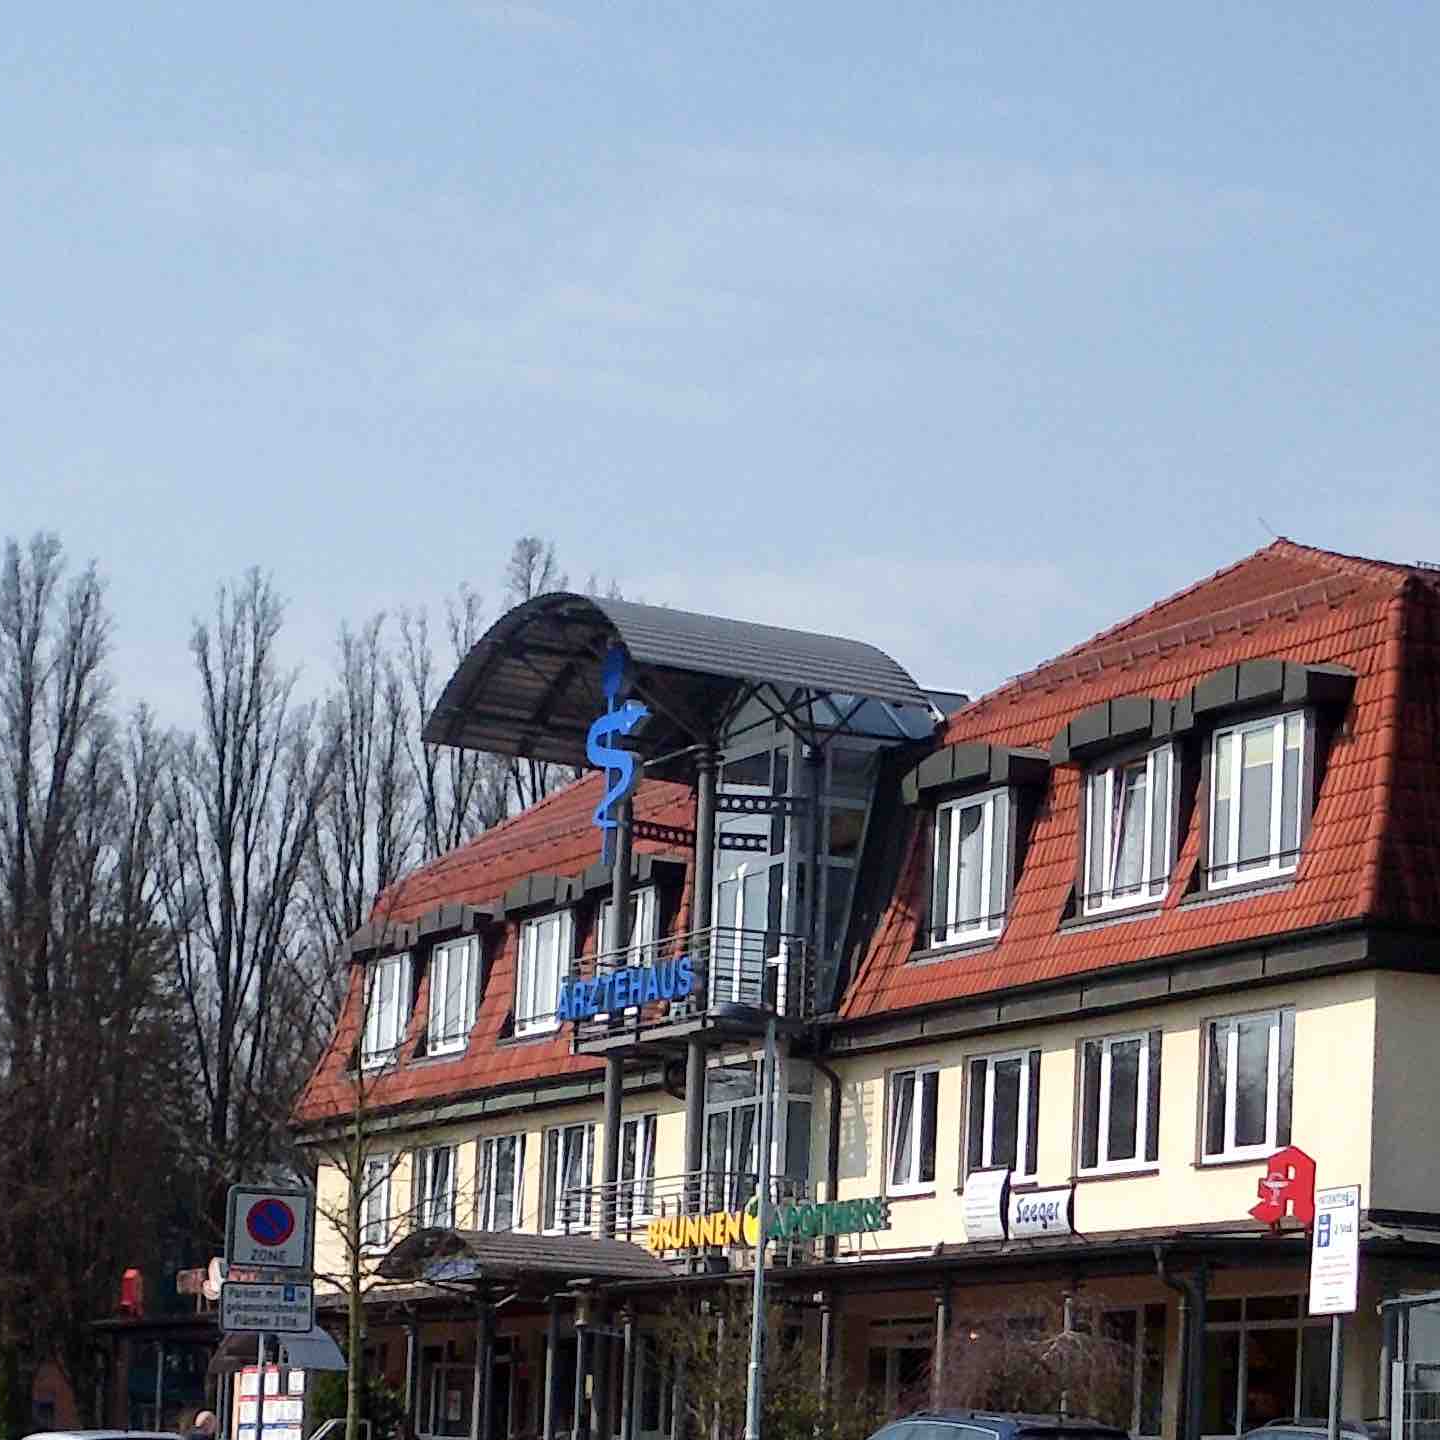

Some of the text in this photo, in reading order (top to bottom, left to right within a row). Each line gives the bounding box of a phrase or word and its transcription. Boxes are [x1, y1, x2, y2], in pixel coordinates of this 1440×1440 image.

[648, 1198, 891, 1252] BRUNNEN APOTHEKE
[1016, 1198, 1059, 1229] Seeger
[250, 1249, 288, 1261] ZONE
